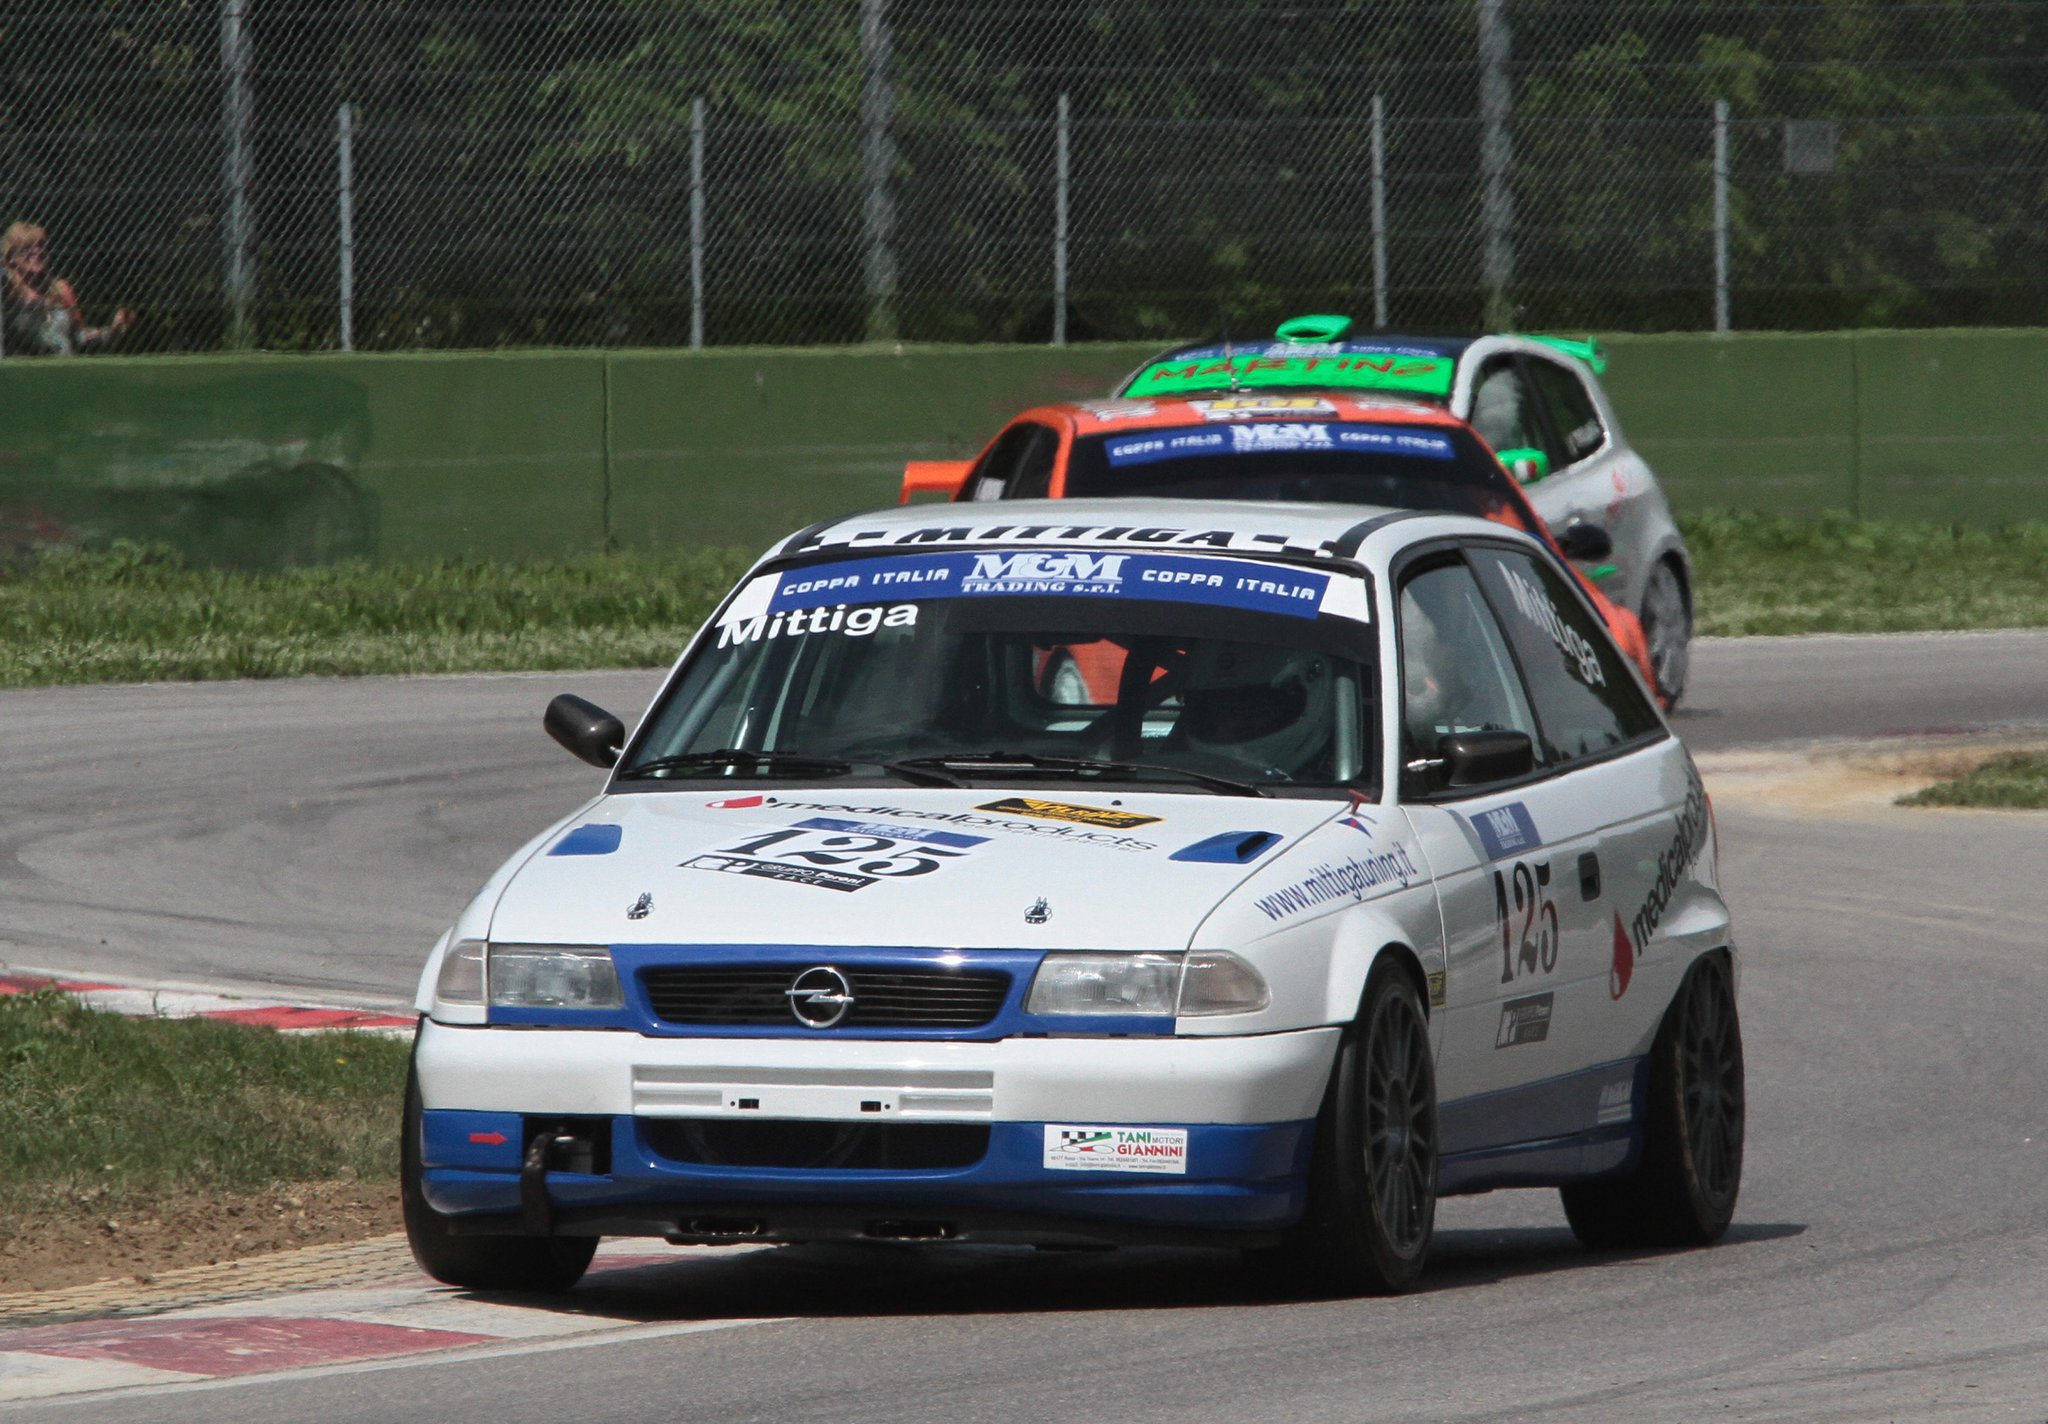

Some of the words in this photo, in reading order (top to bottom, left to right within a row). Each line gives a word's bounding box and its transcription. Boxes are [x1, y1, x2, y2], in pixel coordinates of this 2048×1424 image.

[895, 525, 1236, 547] MITTIGA
[968, 553, 1131, 580] M&M
[783, 575, 860, 596] COPPA
[872, 568, 949, 586] ITALIA
[962, 582, 1067, 593] TRADING
[1141, 569, 1224, 587] COPPA
[1236, 578, 1316, 600] ITALIA
[717, 604, 919, 650] Mittiga
[768, 801, 1159, 851] medicalproducts
[714, 829, 971, 877] 125
[1253, 841, 1418, 921] www.mittigatuning.it
[1494, 861, 1559, 984] 125
[1117, 1131, 1151, 1143] TANI
[1152, 1137, 1184, 1145] MOTORI
[1117, 1144, 1183, 1157] GIANNINI
